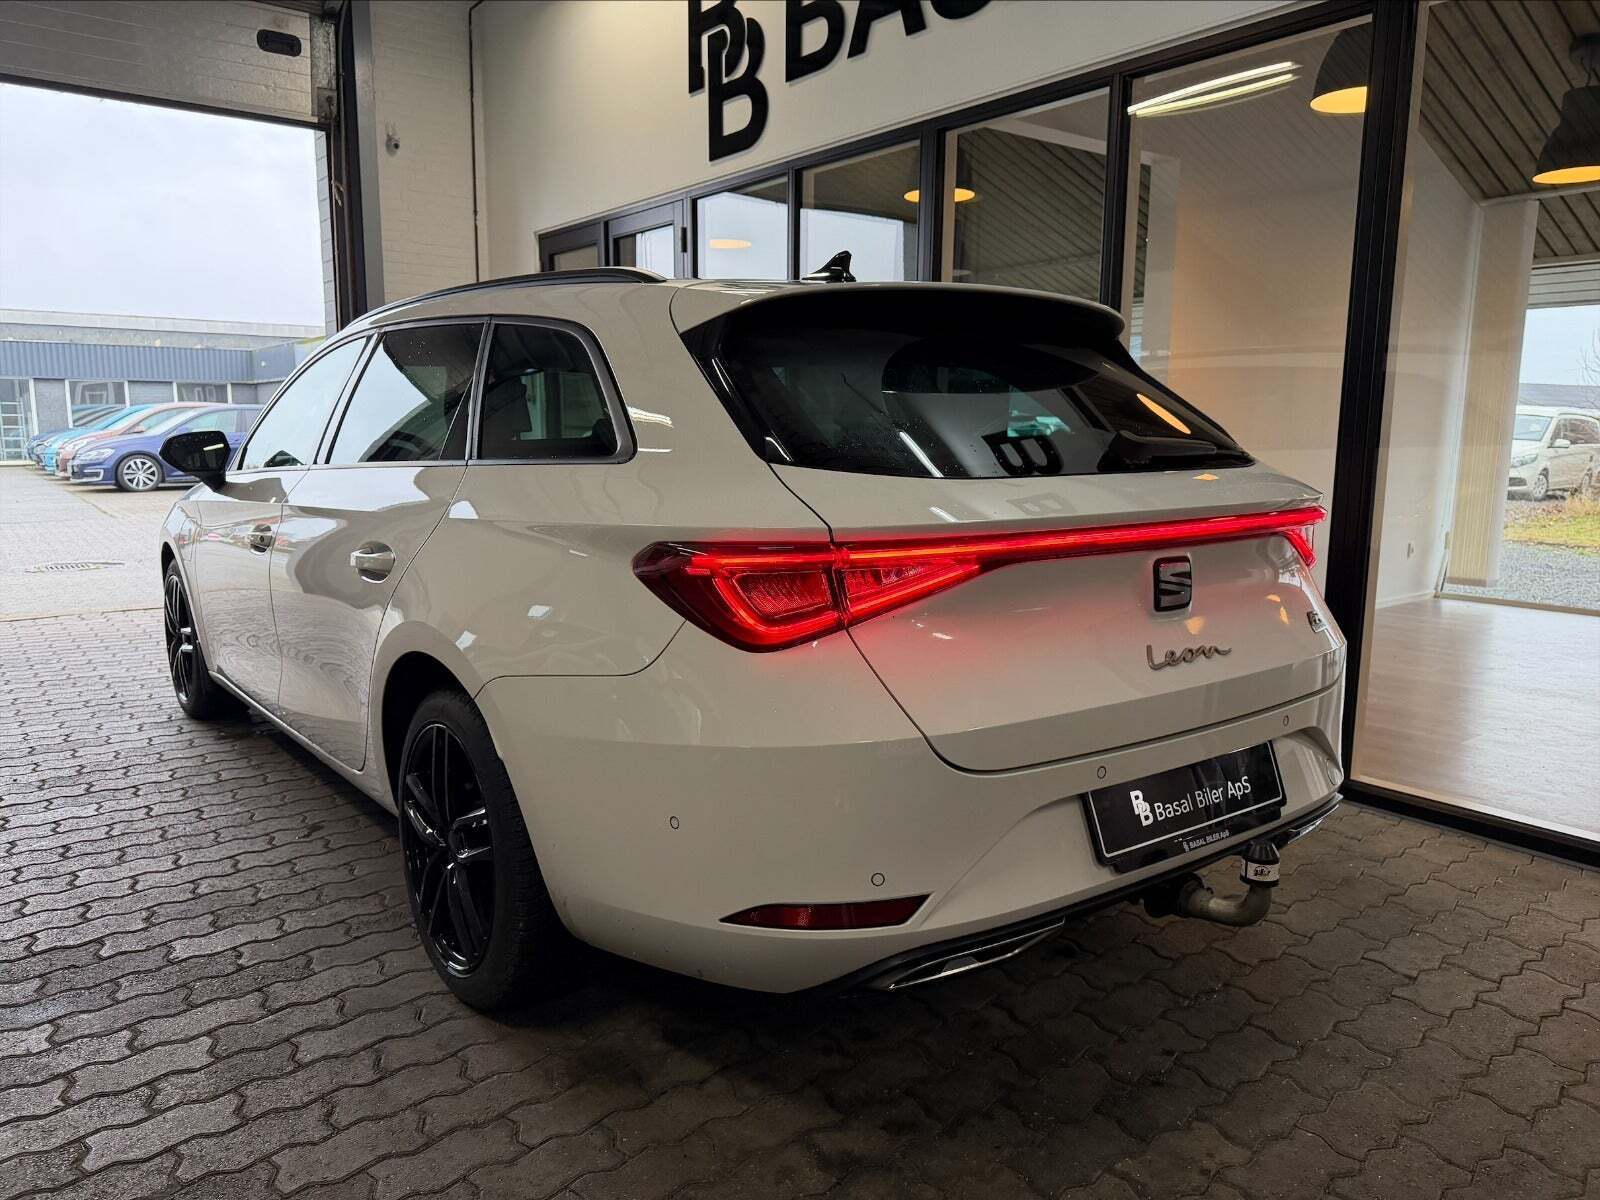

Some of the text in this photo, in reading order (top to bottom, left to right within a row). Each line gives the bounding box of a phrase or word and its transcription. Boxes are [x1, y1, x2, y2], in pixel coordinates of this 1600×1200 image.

[1146, 644, 1232, 671] Leon
[1154, 793, 1193, 821] Basal
[1195, 787, 1223, 808] Biler
[1227, 775, 1251, 800] ApS
[1189, 838, 1206, 849] BASAL
[1206, 832, 1220, 843] BILER
